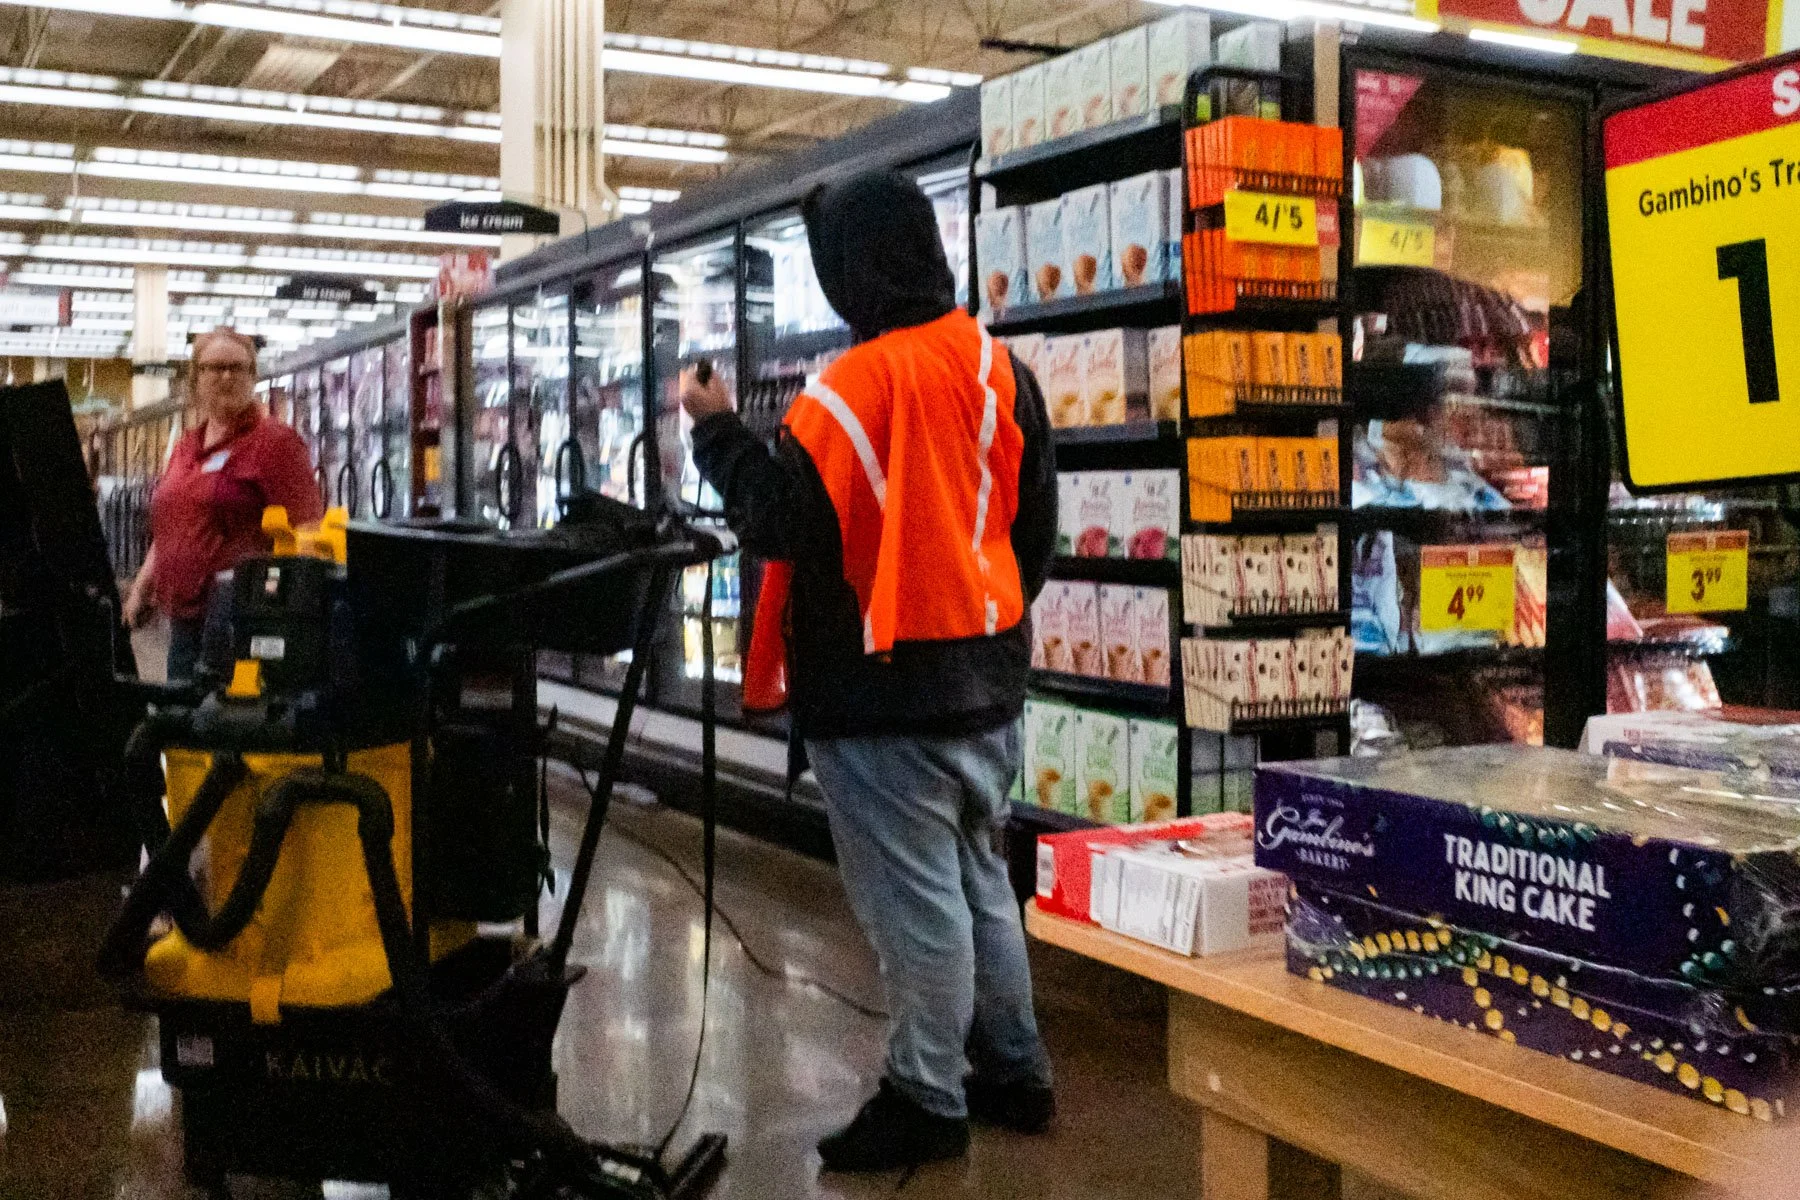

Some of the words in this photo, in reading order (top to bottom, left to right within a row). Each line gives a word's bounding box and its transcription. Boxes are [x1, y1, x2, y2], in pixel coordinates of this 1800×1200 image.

[1518, 0, 1708, 48] ALE
[1638, 167, 1761, 217] Gambino's
[1769, 158, 1800, 187] Tr
[1716, 238, 1780, 403] 1
[1443, 833, 1611, 899] TRADITIONAL
[1455, 869, 1516, 913] KING
[1522, 885, 1596, 932] CAKE
